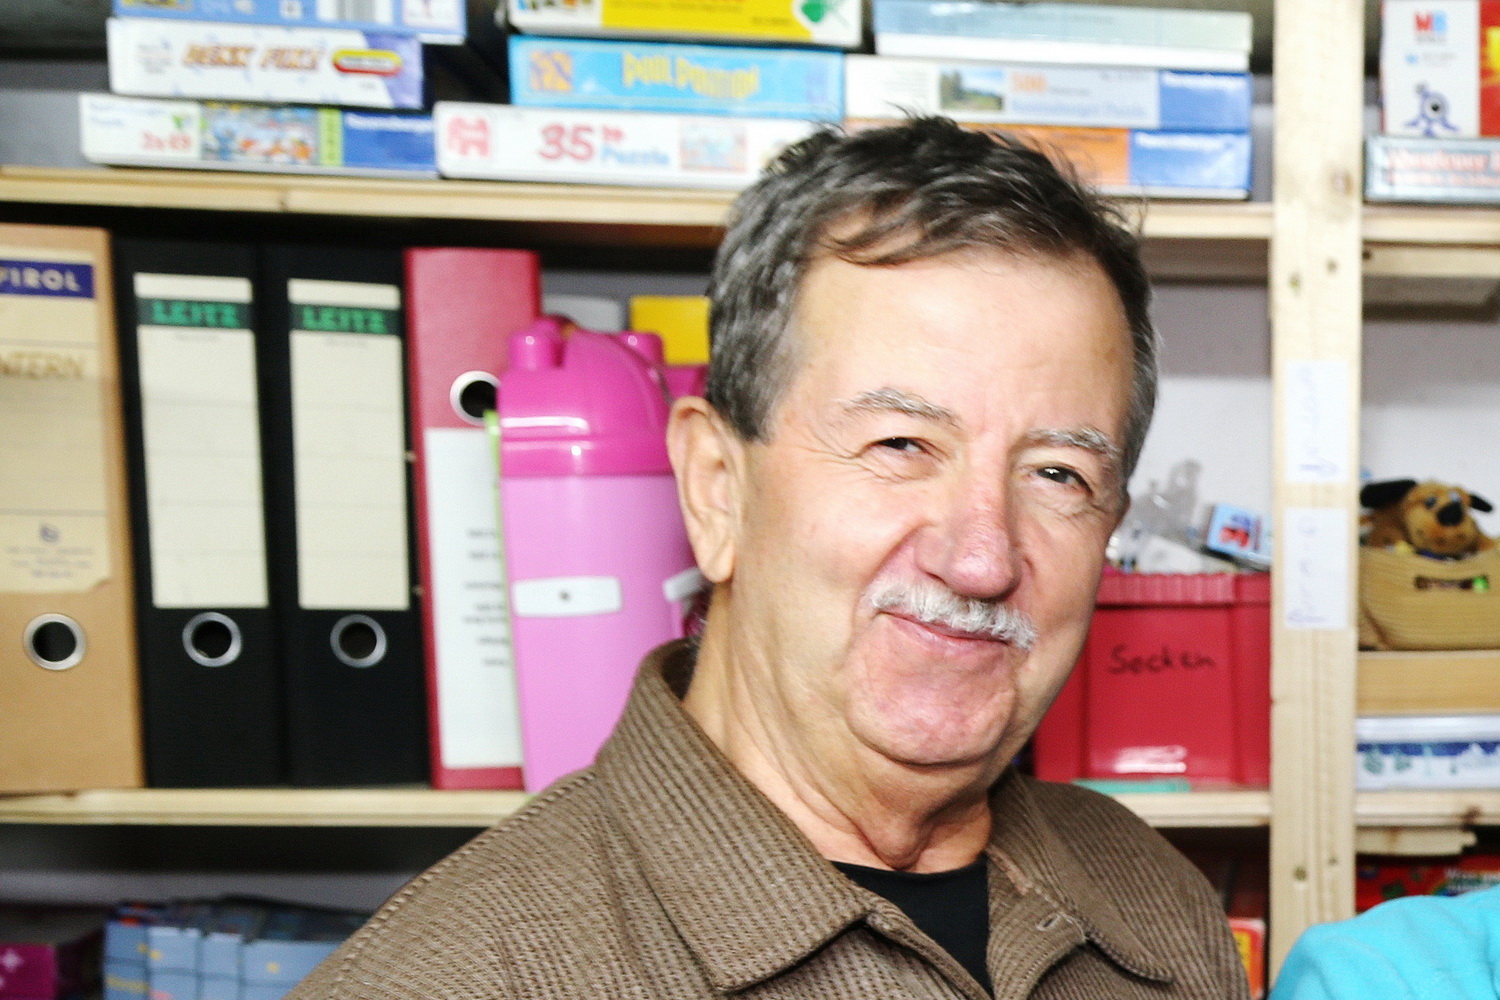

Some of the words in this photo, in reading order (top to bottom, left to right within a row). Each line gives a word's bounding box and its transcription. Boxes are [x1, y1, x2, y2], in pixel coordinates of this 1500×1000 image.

[538, 124, 596, 160] 35
[152, 301, 240, 328] LEITZ
[302, 307, 388, 334] LEITZ
